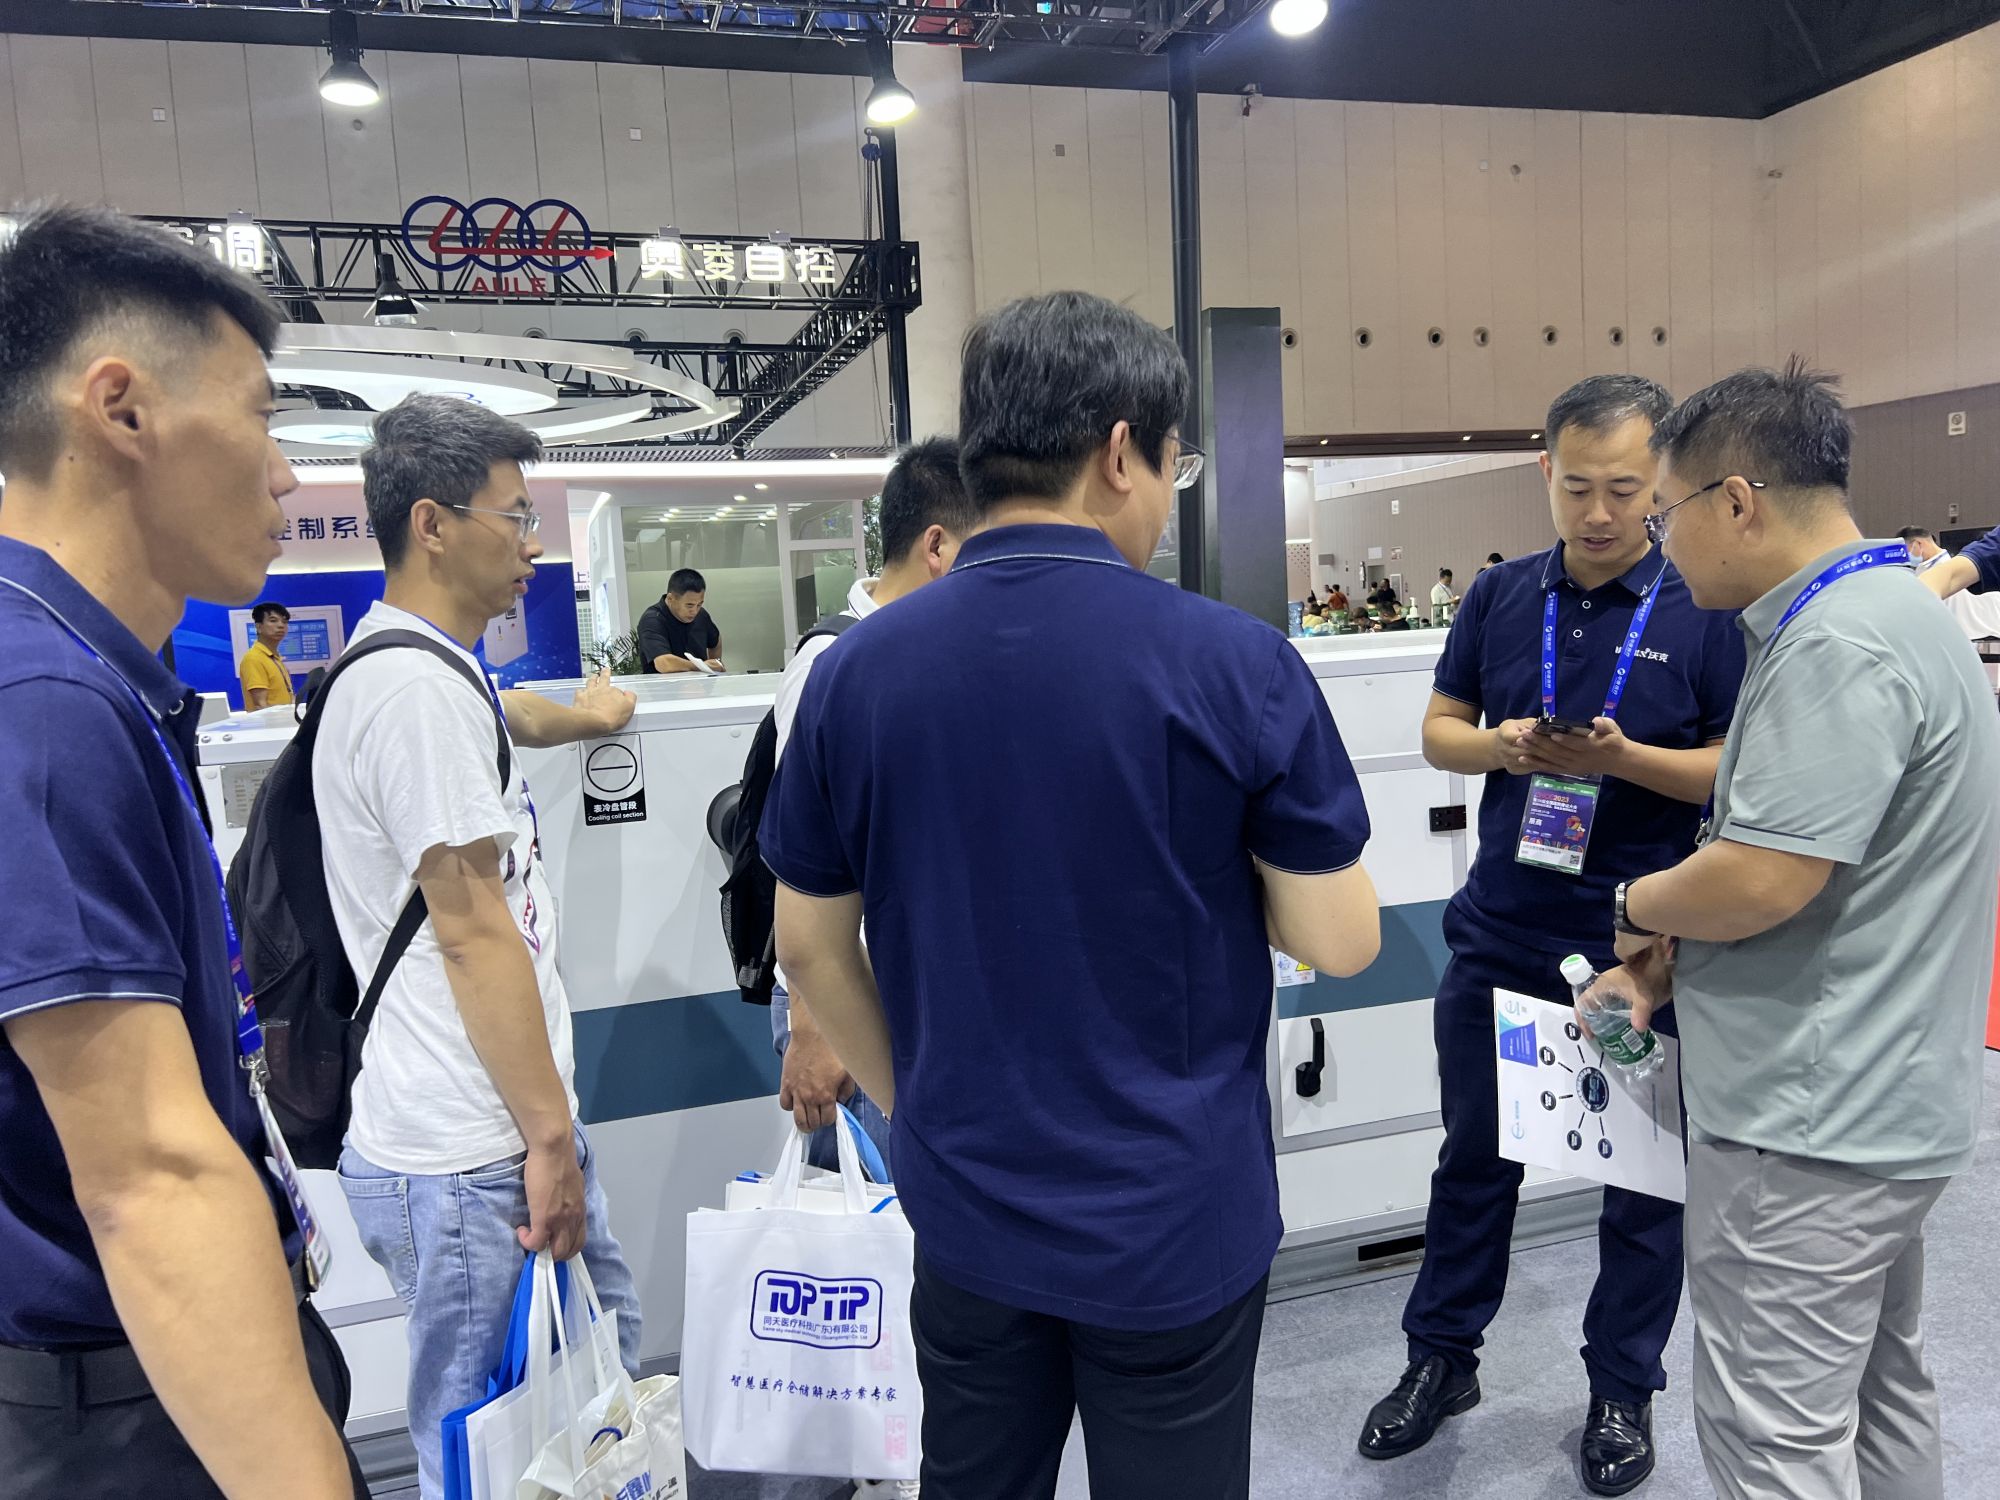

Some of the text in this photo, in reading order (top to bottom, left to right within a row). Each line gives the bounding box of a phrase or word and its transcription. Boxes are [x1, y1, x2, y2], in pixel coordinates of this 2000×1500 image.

[640, 240, 836, 283] 奥凌自控
[471, 276, 547, 295] AULE
[588, 814, 611, 822] Cooling
[622, 811, 644, 819] section
[593, 801, 637, 813] 表冷盘管段
[730, 1374, 898, 1402] 智慧医疗仓储解决方案专家
